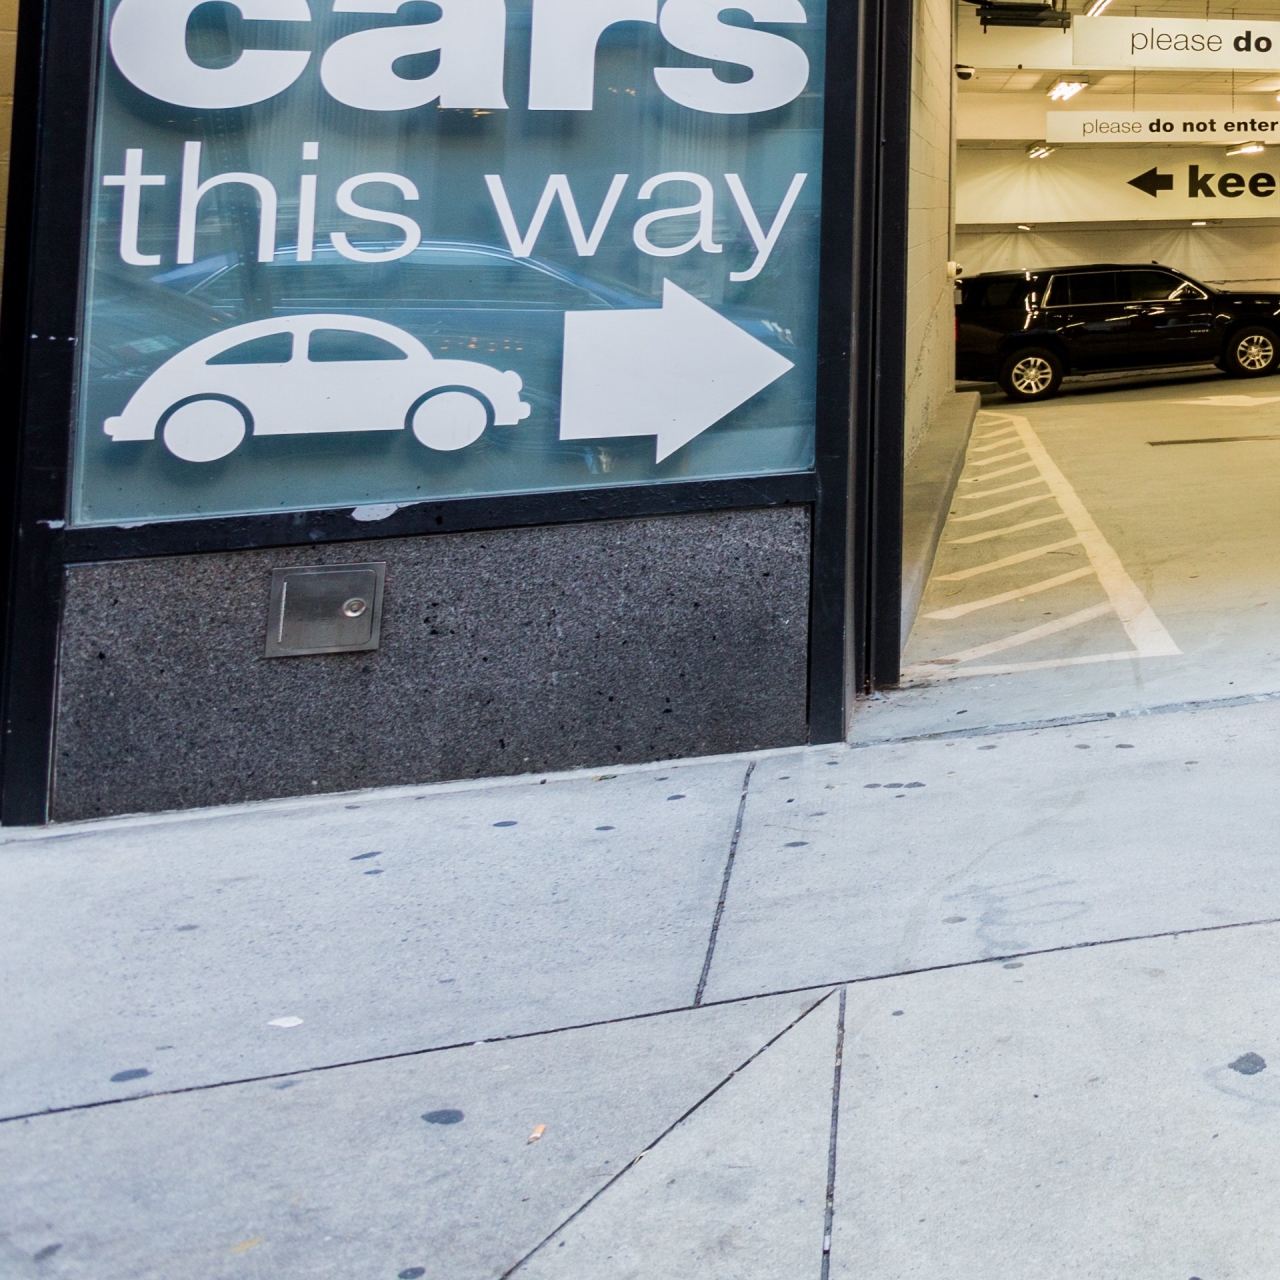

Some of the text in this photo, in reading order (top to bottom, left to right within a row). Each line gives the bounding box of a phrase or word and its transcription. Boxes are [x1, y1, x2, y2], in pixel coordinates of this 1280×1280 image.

[1130, 27, 1222, 55] please
[1232, 30, 1272, 53] do
[1082, 118, 1279, 137] please do not enter
[103, 141, 808, 282] this way
